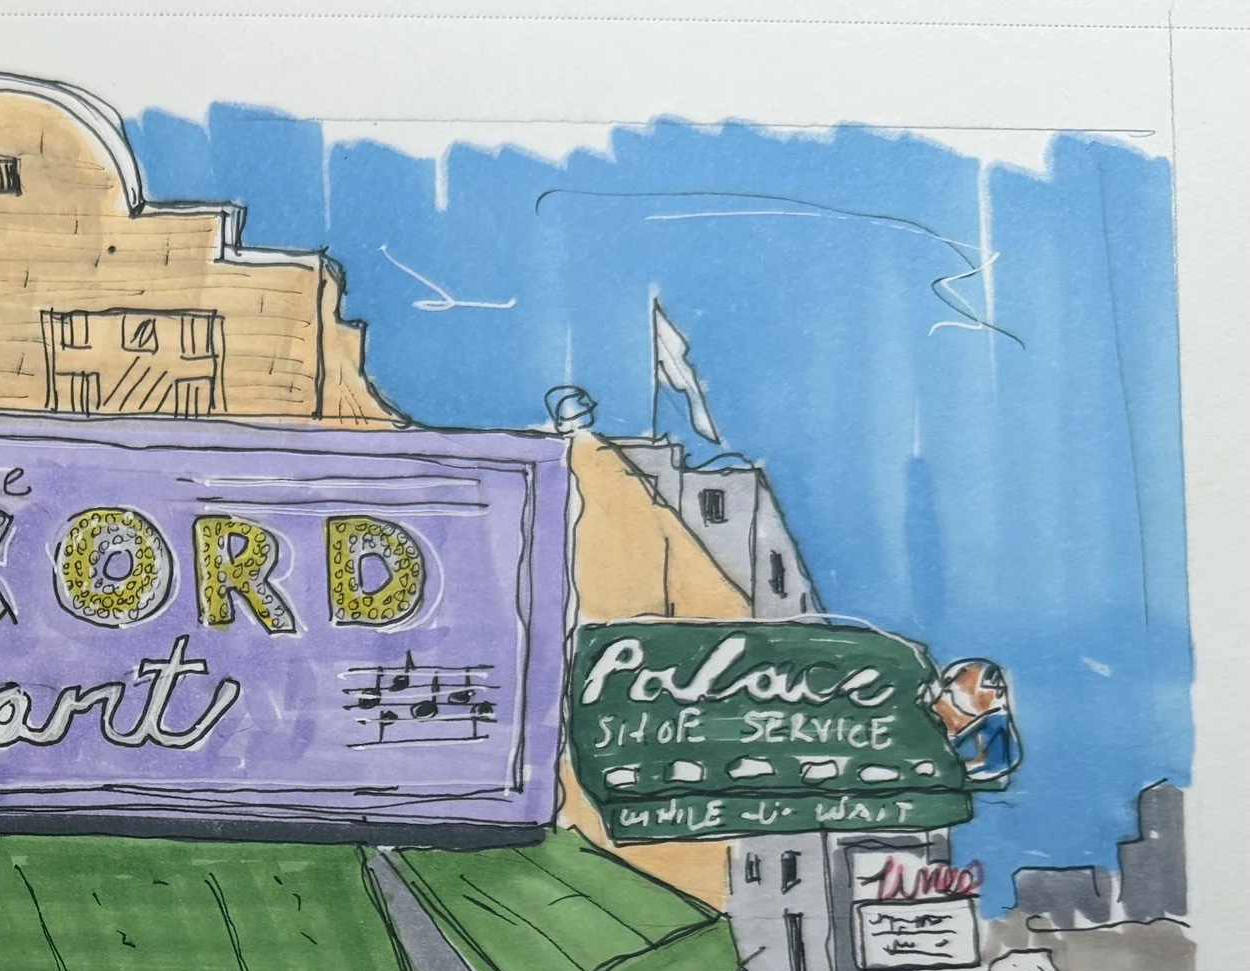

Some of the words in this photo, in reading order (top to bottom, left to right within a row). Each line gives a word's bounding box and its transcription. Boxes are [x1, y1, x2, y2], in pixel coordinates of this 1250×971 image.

[581, 631, 895, 706] Palace
[739, 710, 896, 750] SERVICE
[815, 796, 914, 824] WAIT
